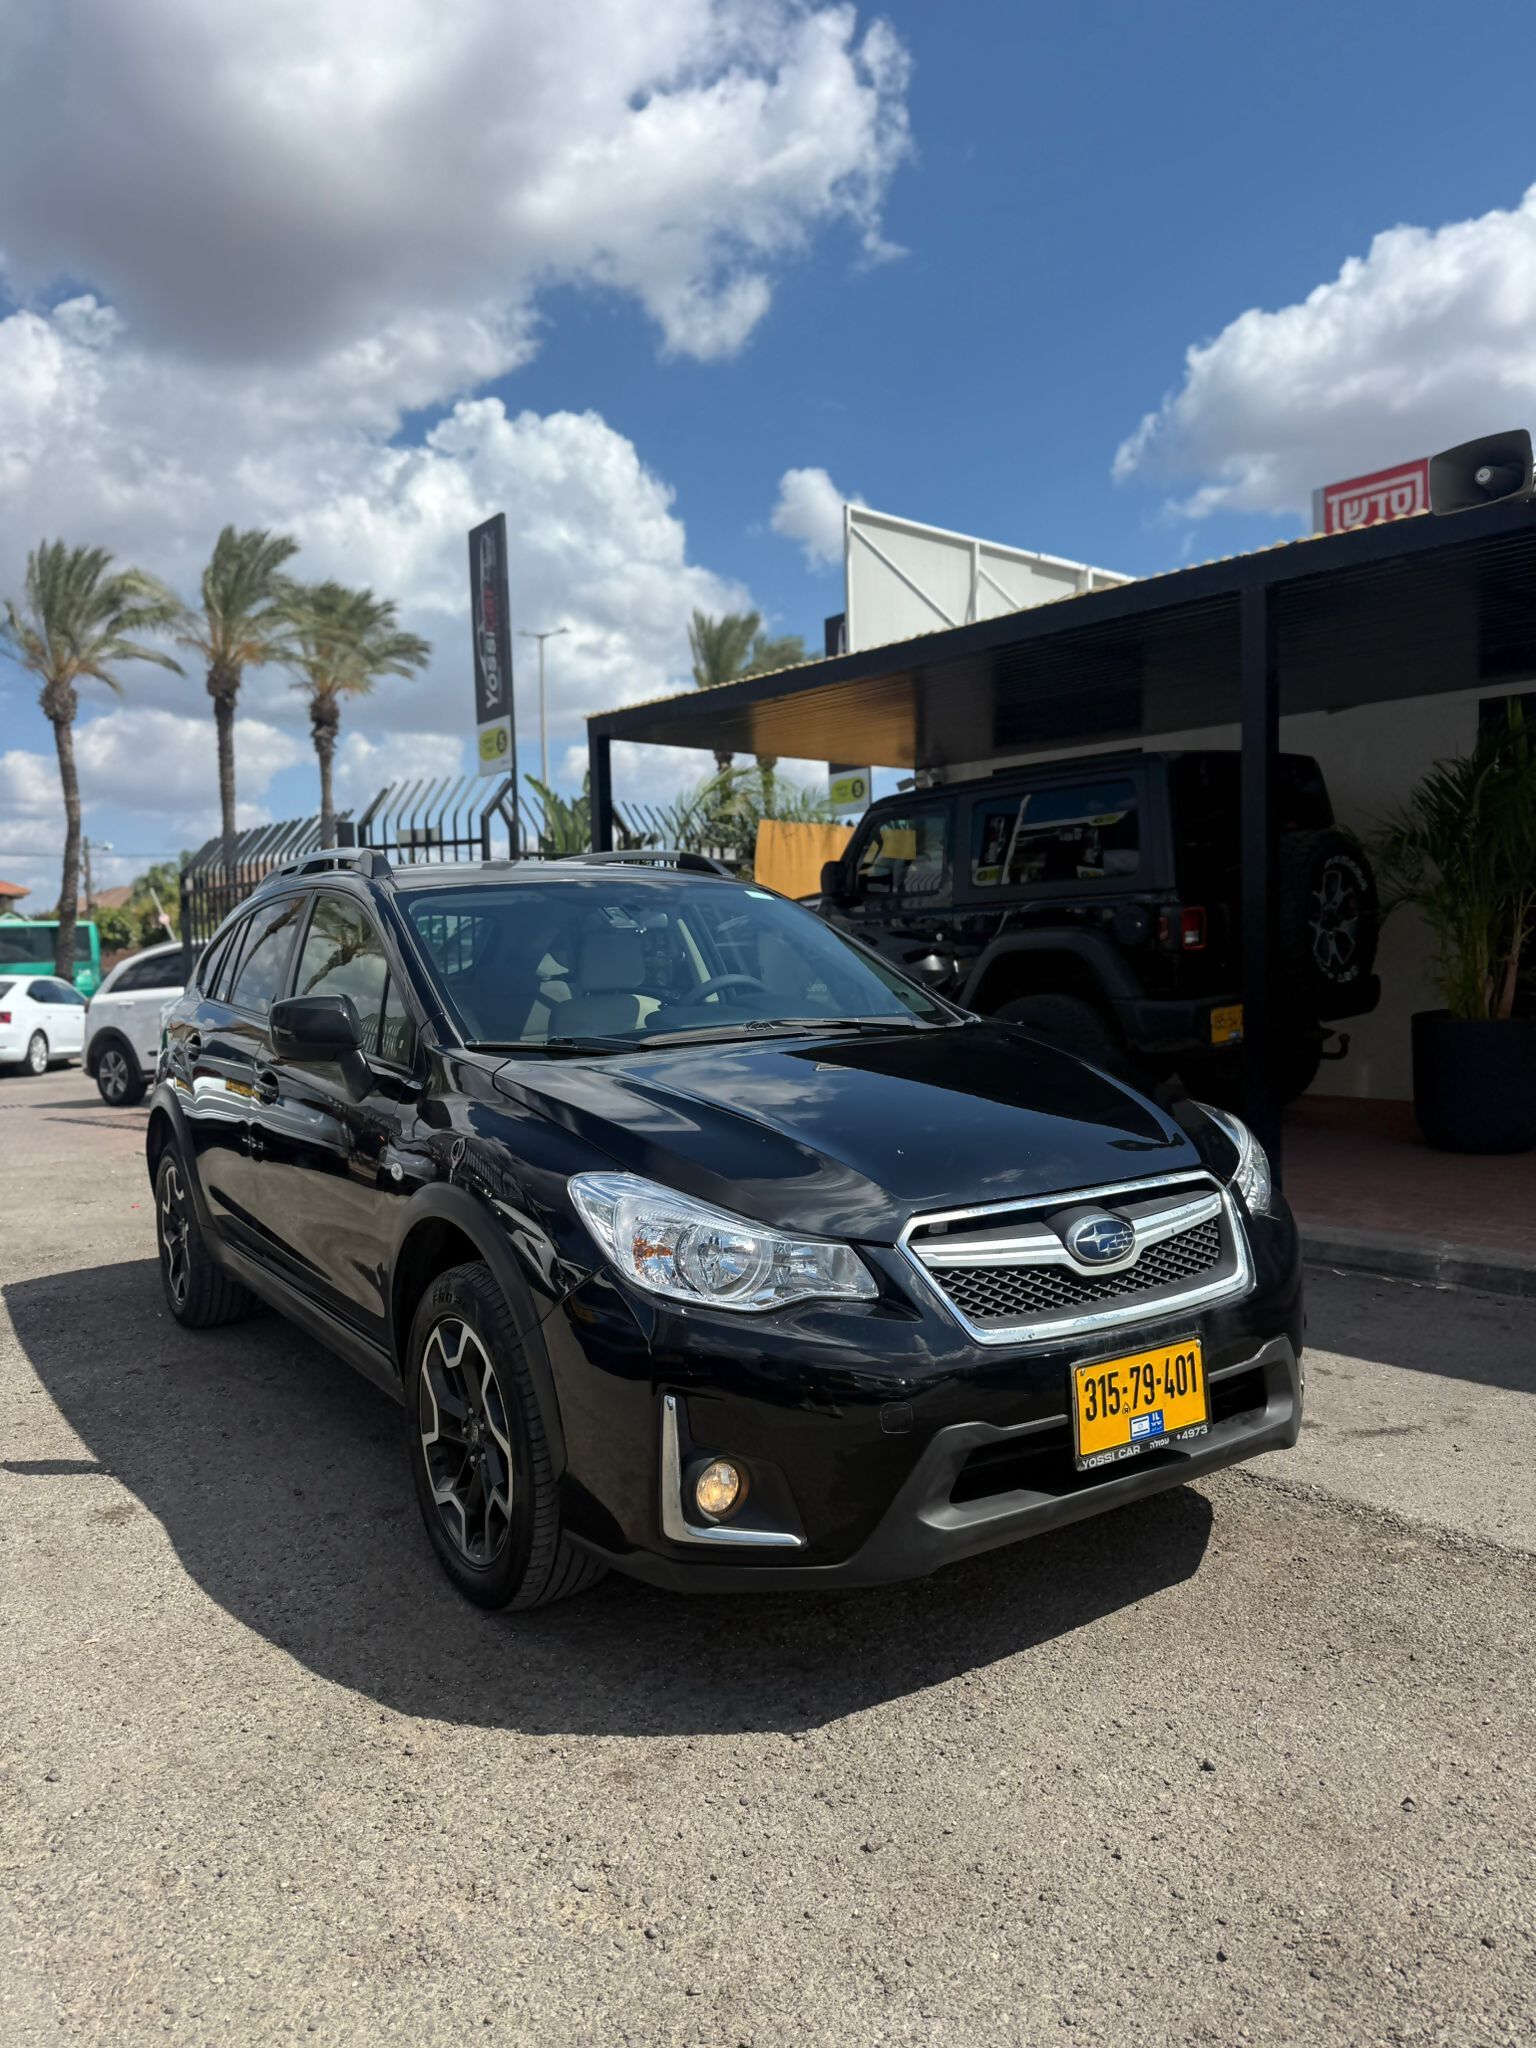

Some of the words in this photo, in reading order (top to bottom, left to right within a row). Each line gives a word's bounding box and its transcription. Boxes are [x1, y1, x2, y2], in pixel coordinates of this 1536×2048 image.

[1082, 1453, 1115, 1470] YOSSI
[1118, 1445, 1140, 1459] CAR
[1149, 1437, 1170, 1449] עפולה
